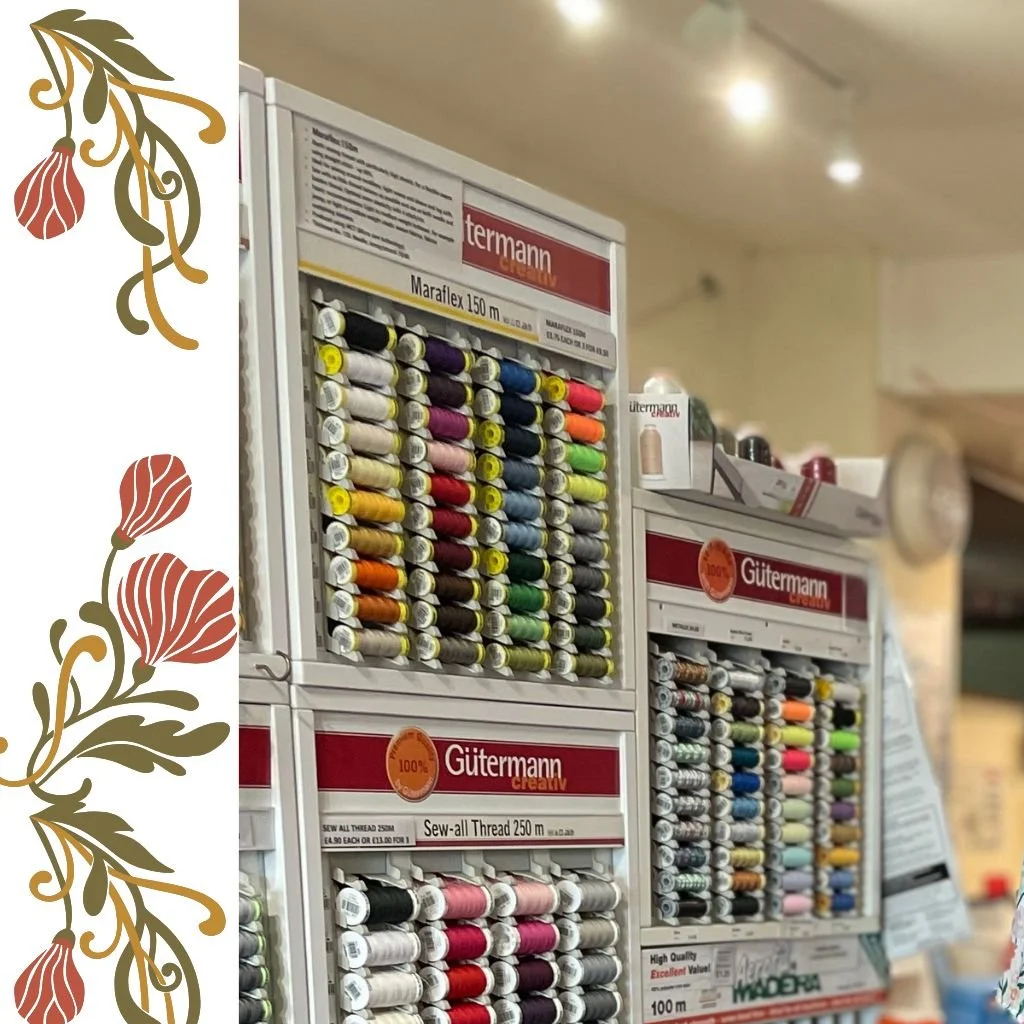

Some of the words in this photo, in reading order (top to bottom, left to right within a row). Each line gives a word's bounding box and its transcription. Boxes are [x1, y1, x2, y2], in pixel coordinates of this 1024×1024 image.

[465, 213, 551, 274] termann
[499, 255, 558, 287] creativ
[410, 274, 464, 309] Maraflex
[467, 293, 486, 317] 150
[489, 305, 500, 321] m
[741, 557, 827, 599] Gütermann
[789, 592, 831, 610] creativ
[399, 759, 428, 773] 100%
[445, 744, 562, 779] Gütermann
[511, 775, 567, 791] creativ
[339, 824, 350, 832] ALL
[351, 824, 376, 832] THREAD
[378, 824, 395, 832] 250M
[424, 819, 469, 838] Sew-all
[471, 820, 511, 837] Thread
[513, 821, 532, 836] 250
[534, 825, 545, 836] m
[650, 954, 668, 965] High
[670, 951, 697, 962] Quality
[650, 967, 686, 979] Excellent
[688, 963, 711, 974] Value!
[651, 998, 673, 1016] 100
[675, 1000, 686, 1012] m
